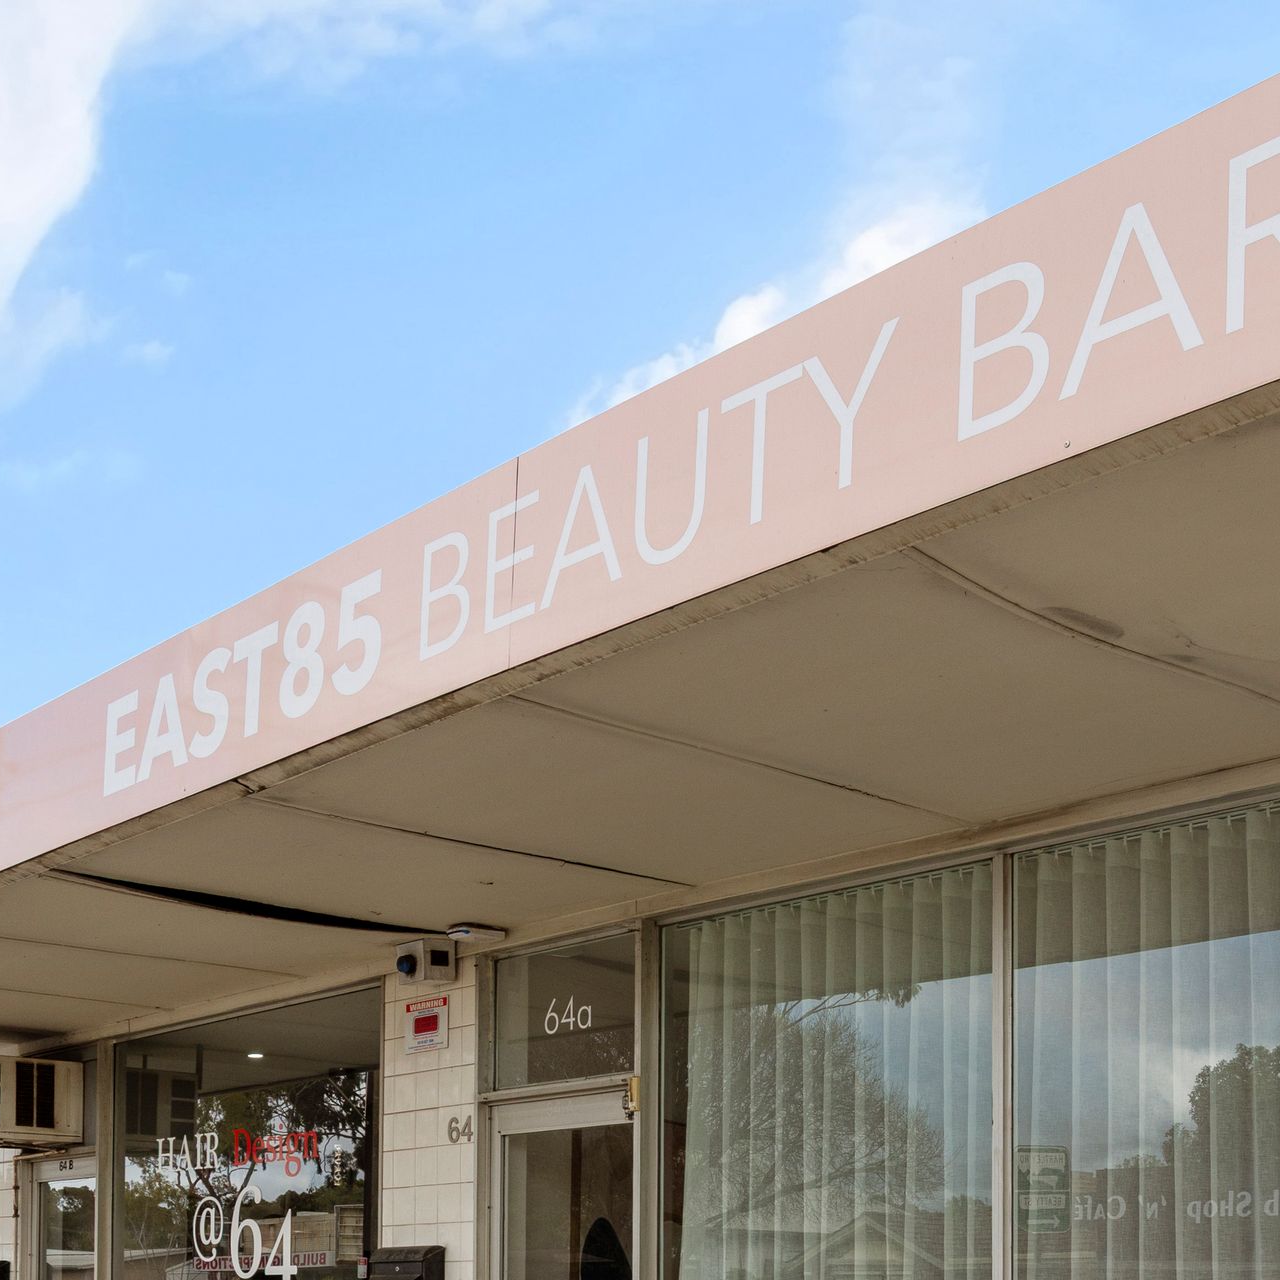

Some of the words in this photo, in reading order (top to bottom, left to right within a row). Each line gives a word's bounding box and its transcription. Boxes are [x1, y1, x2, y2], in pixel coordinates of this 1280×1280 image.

[103, 571, 382, 798] EAST85
[418, 316, 900, 662] BEAUTY
[543, 996, 592, 1036] 64a
[156, 1132, 220, 1173] HAIR
[232, 1123, 319, 1177] Design
[447, 1115, 474, 1144] 64
[192, 1196, 224, 1263] @
